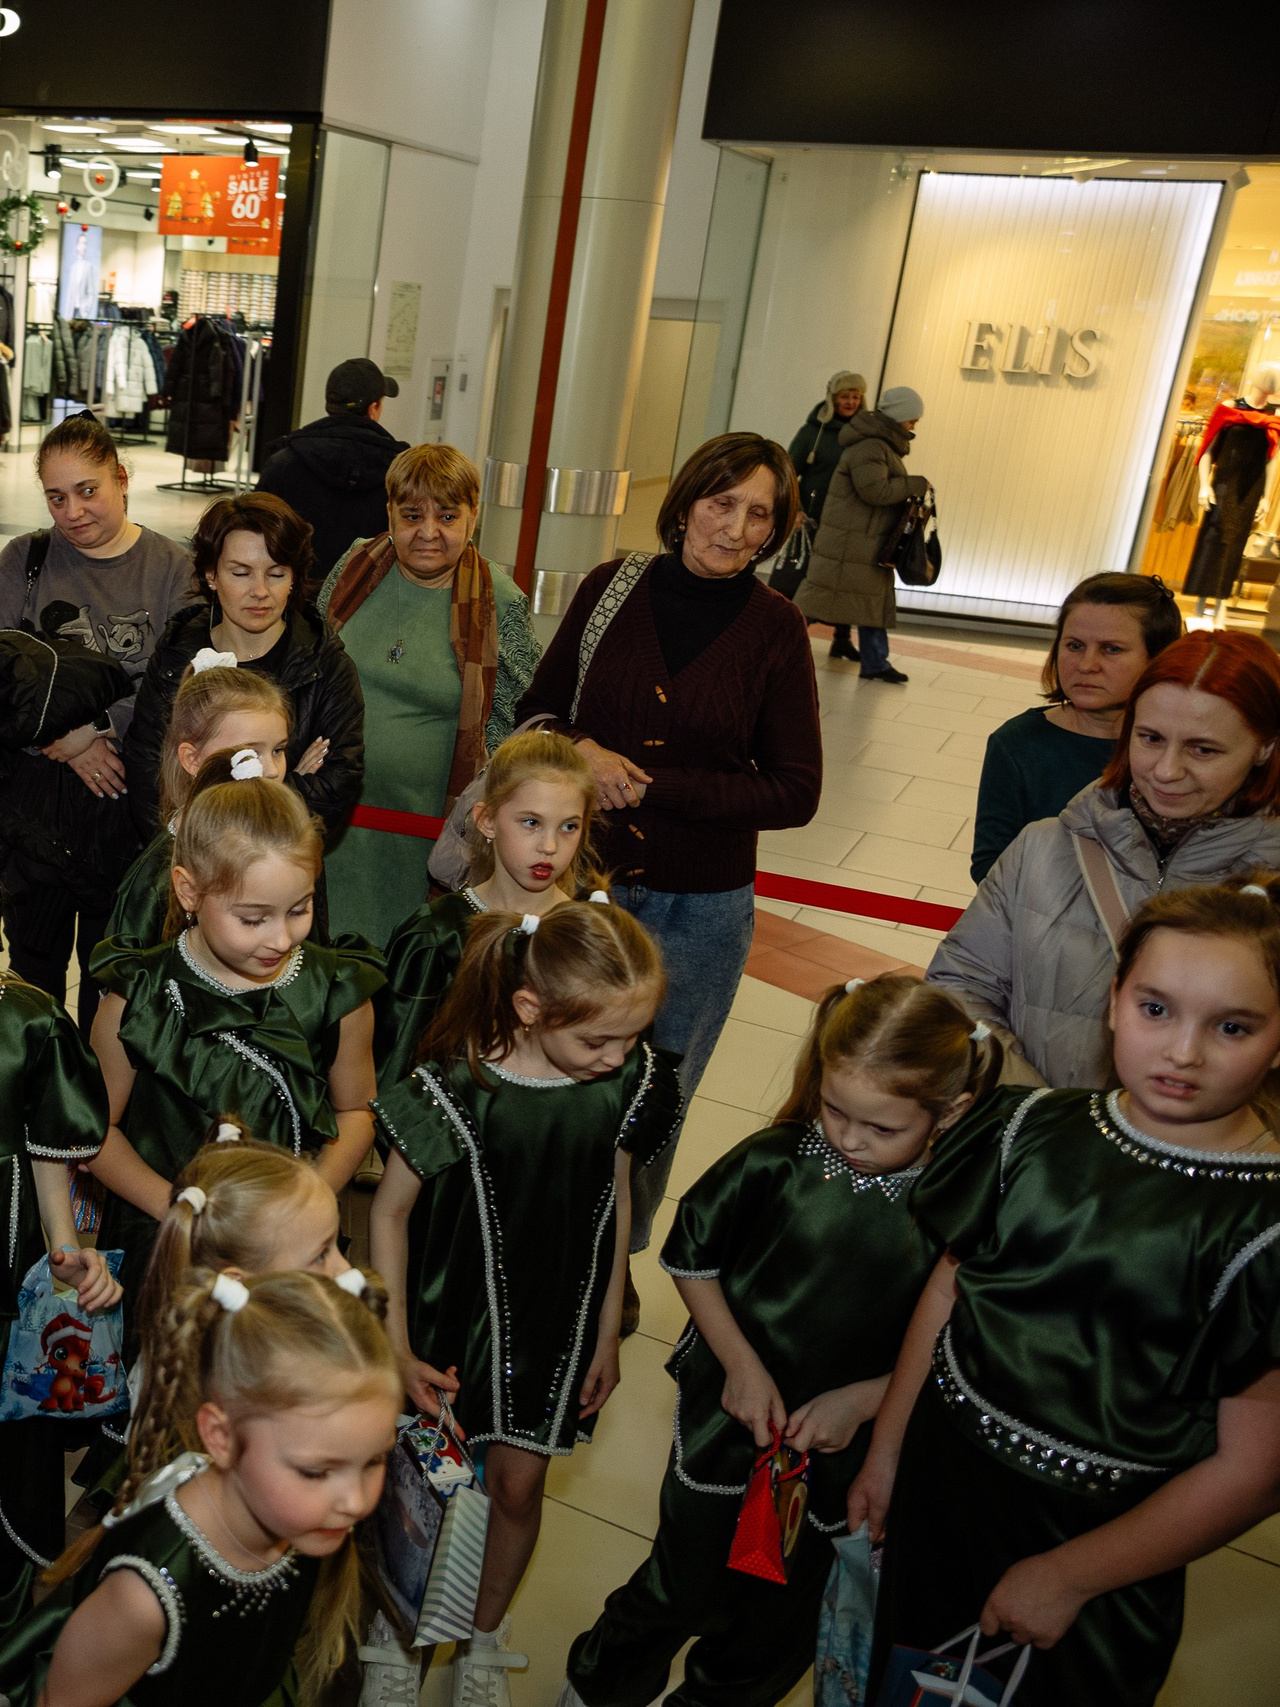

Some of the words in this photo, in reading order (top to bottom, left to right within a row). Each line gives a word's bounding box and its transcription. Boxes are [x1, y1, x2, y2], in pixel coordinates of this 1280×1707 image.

[229, 170, 269, 181] WINTER
[227, 176, 270, 196] SALE
[959, 320, 1101, 379] ELIS
